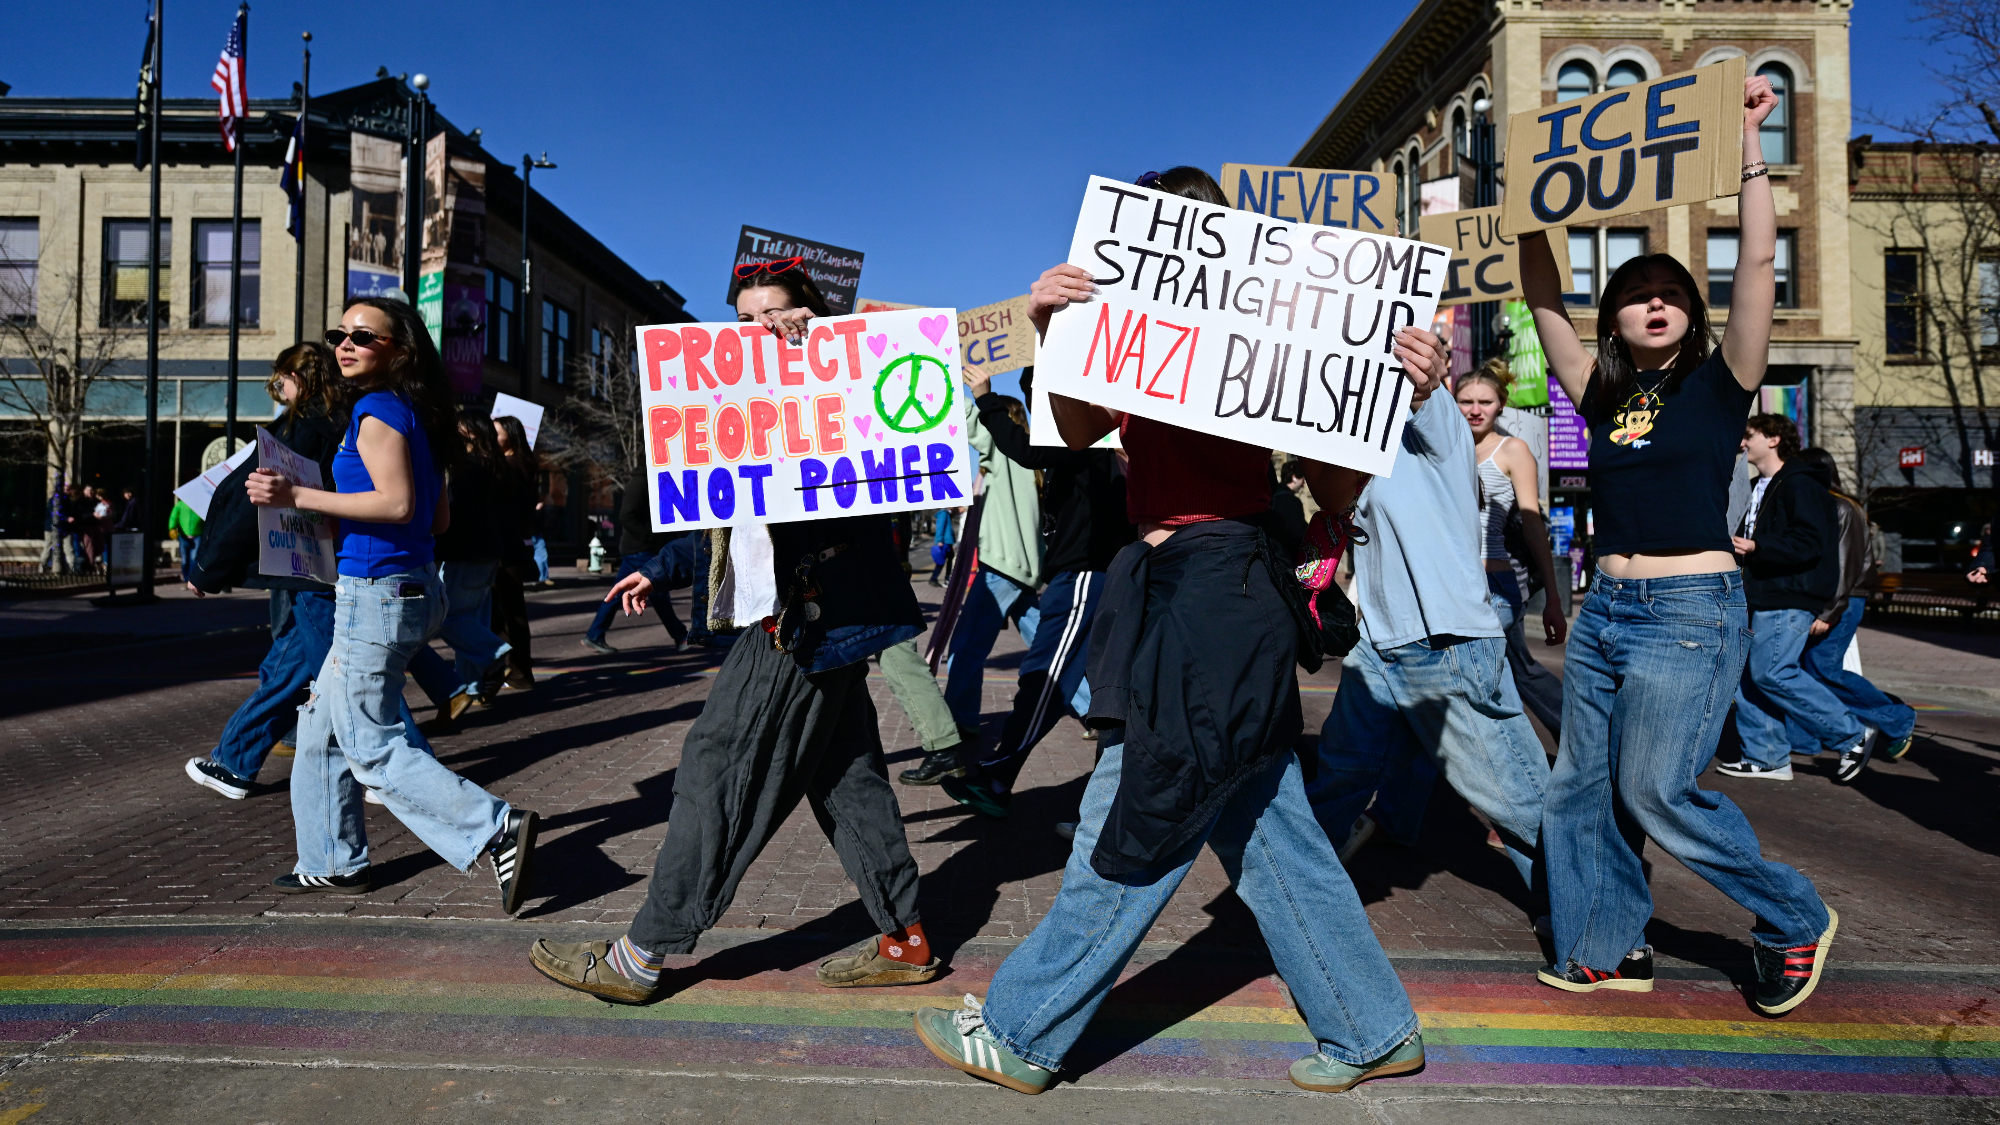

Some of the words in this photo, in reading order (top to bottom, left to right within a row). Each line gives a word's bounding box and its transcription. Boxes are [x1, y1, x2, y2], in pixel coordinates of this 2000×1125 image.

[1532, 74, 1700, 164] ICE
[1238, 169, 1385, 230] NEVER
[1530, 136, 1699, 224] OUT
[745, 231, 795, 257] THEN
[1099, 185, 1227, 260] THIS
[1248, 222, 1293, 266] IS
[1305, 230, 1447, 298] SOME
[1456, 213, 1515, 251] FUC
[837, 276, 859, 287] LEFT
[1092, 239, 1338, 331] STRAIGHT
[1342, 293, 1415, 354] UP
[1440, 254, 1515, 301] IC
[958, 308, 1012, 337] OLISH
[1508, 326, 1540, 354] OWN
[643, 319, 868, 392] PROTECT
[960, 334, 1010, 367] CE
[1082, 302, 1200, 405] NAZI
[1214, 333, 1410, 453] BULLSHIT
[649, 392, 847, 467] PEOPLE
[1555, 425, 1579, 433] CANDLES
[1555, 450, 1586, 458] ASTROLOGY
[657, 463, 773, 525] NOT
[795, 442, 963, 512] POWER
[269, 530, 297, 549] COULD
[279, 513, 304, 534] WHEN
